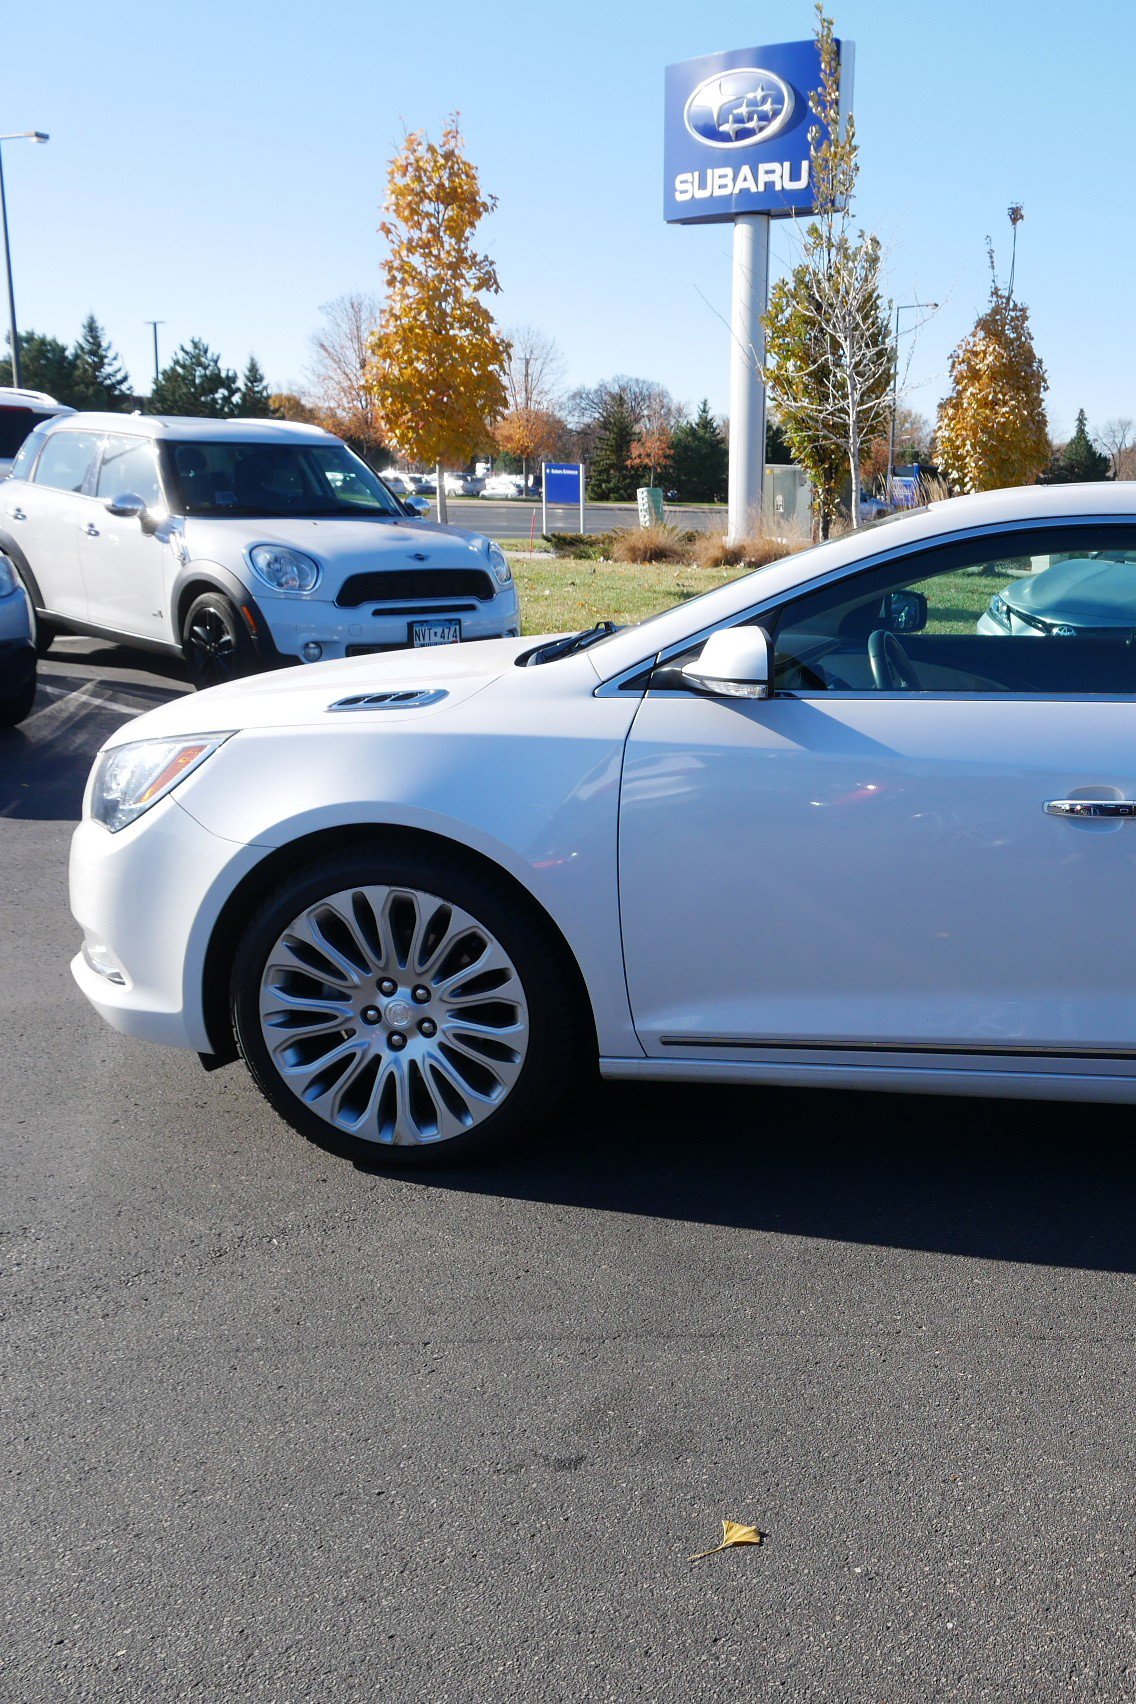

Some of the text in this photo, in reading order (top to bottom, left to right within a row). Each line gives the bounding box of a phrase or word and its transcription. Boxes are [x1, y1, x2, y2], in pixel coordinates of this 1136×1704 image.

[674, 160, 810, 202] SUBARU
[415, 626, 457, 642] NVT 474
